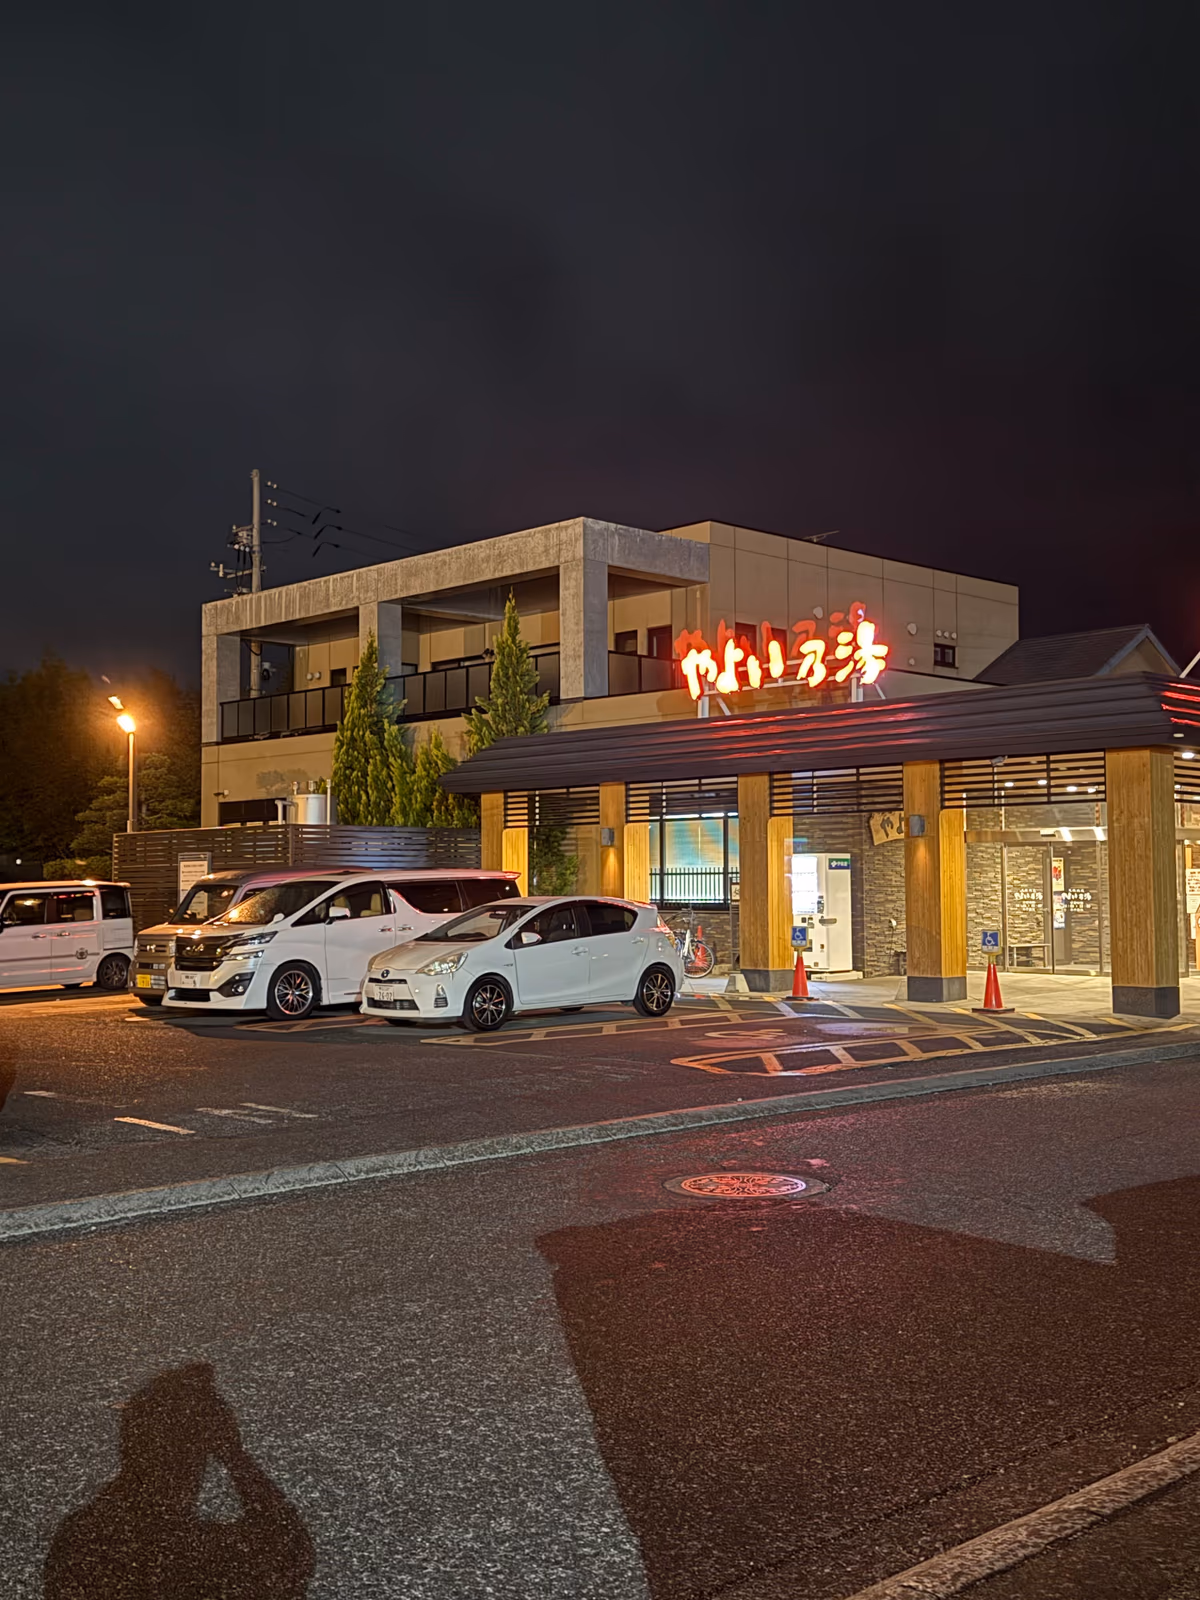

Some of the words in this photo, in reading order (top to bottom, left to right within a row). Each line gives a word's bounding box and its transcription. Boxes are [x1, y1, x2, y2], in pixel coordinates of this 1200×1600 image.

[680, 619, 889, 701] やよい乃湯
